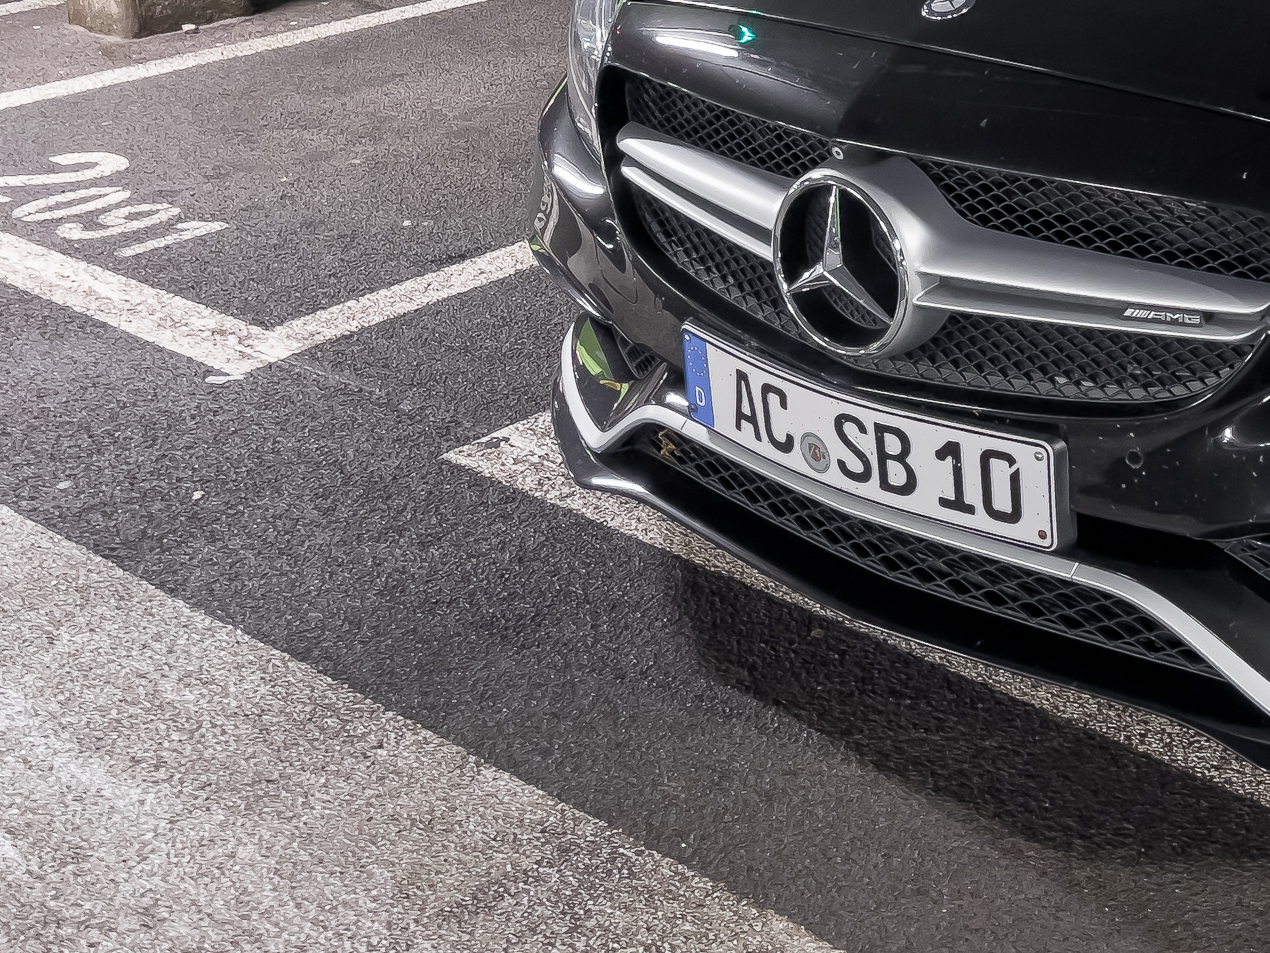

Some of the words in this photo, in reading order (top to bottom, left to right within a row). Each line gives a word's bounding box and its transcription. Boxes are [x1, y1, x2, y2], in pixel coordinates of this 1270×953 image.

[1147, 310, 1201, 324] AMG
[695, 386, 705, 407] D
[735, 368, 795, 454] AC
[834, 412, 917, 496] SB
[935, 439, 1022, 524] 10
